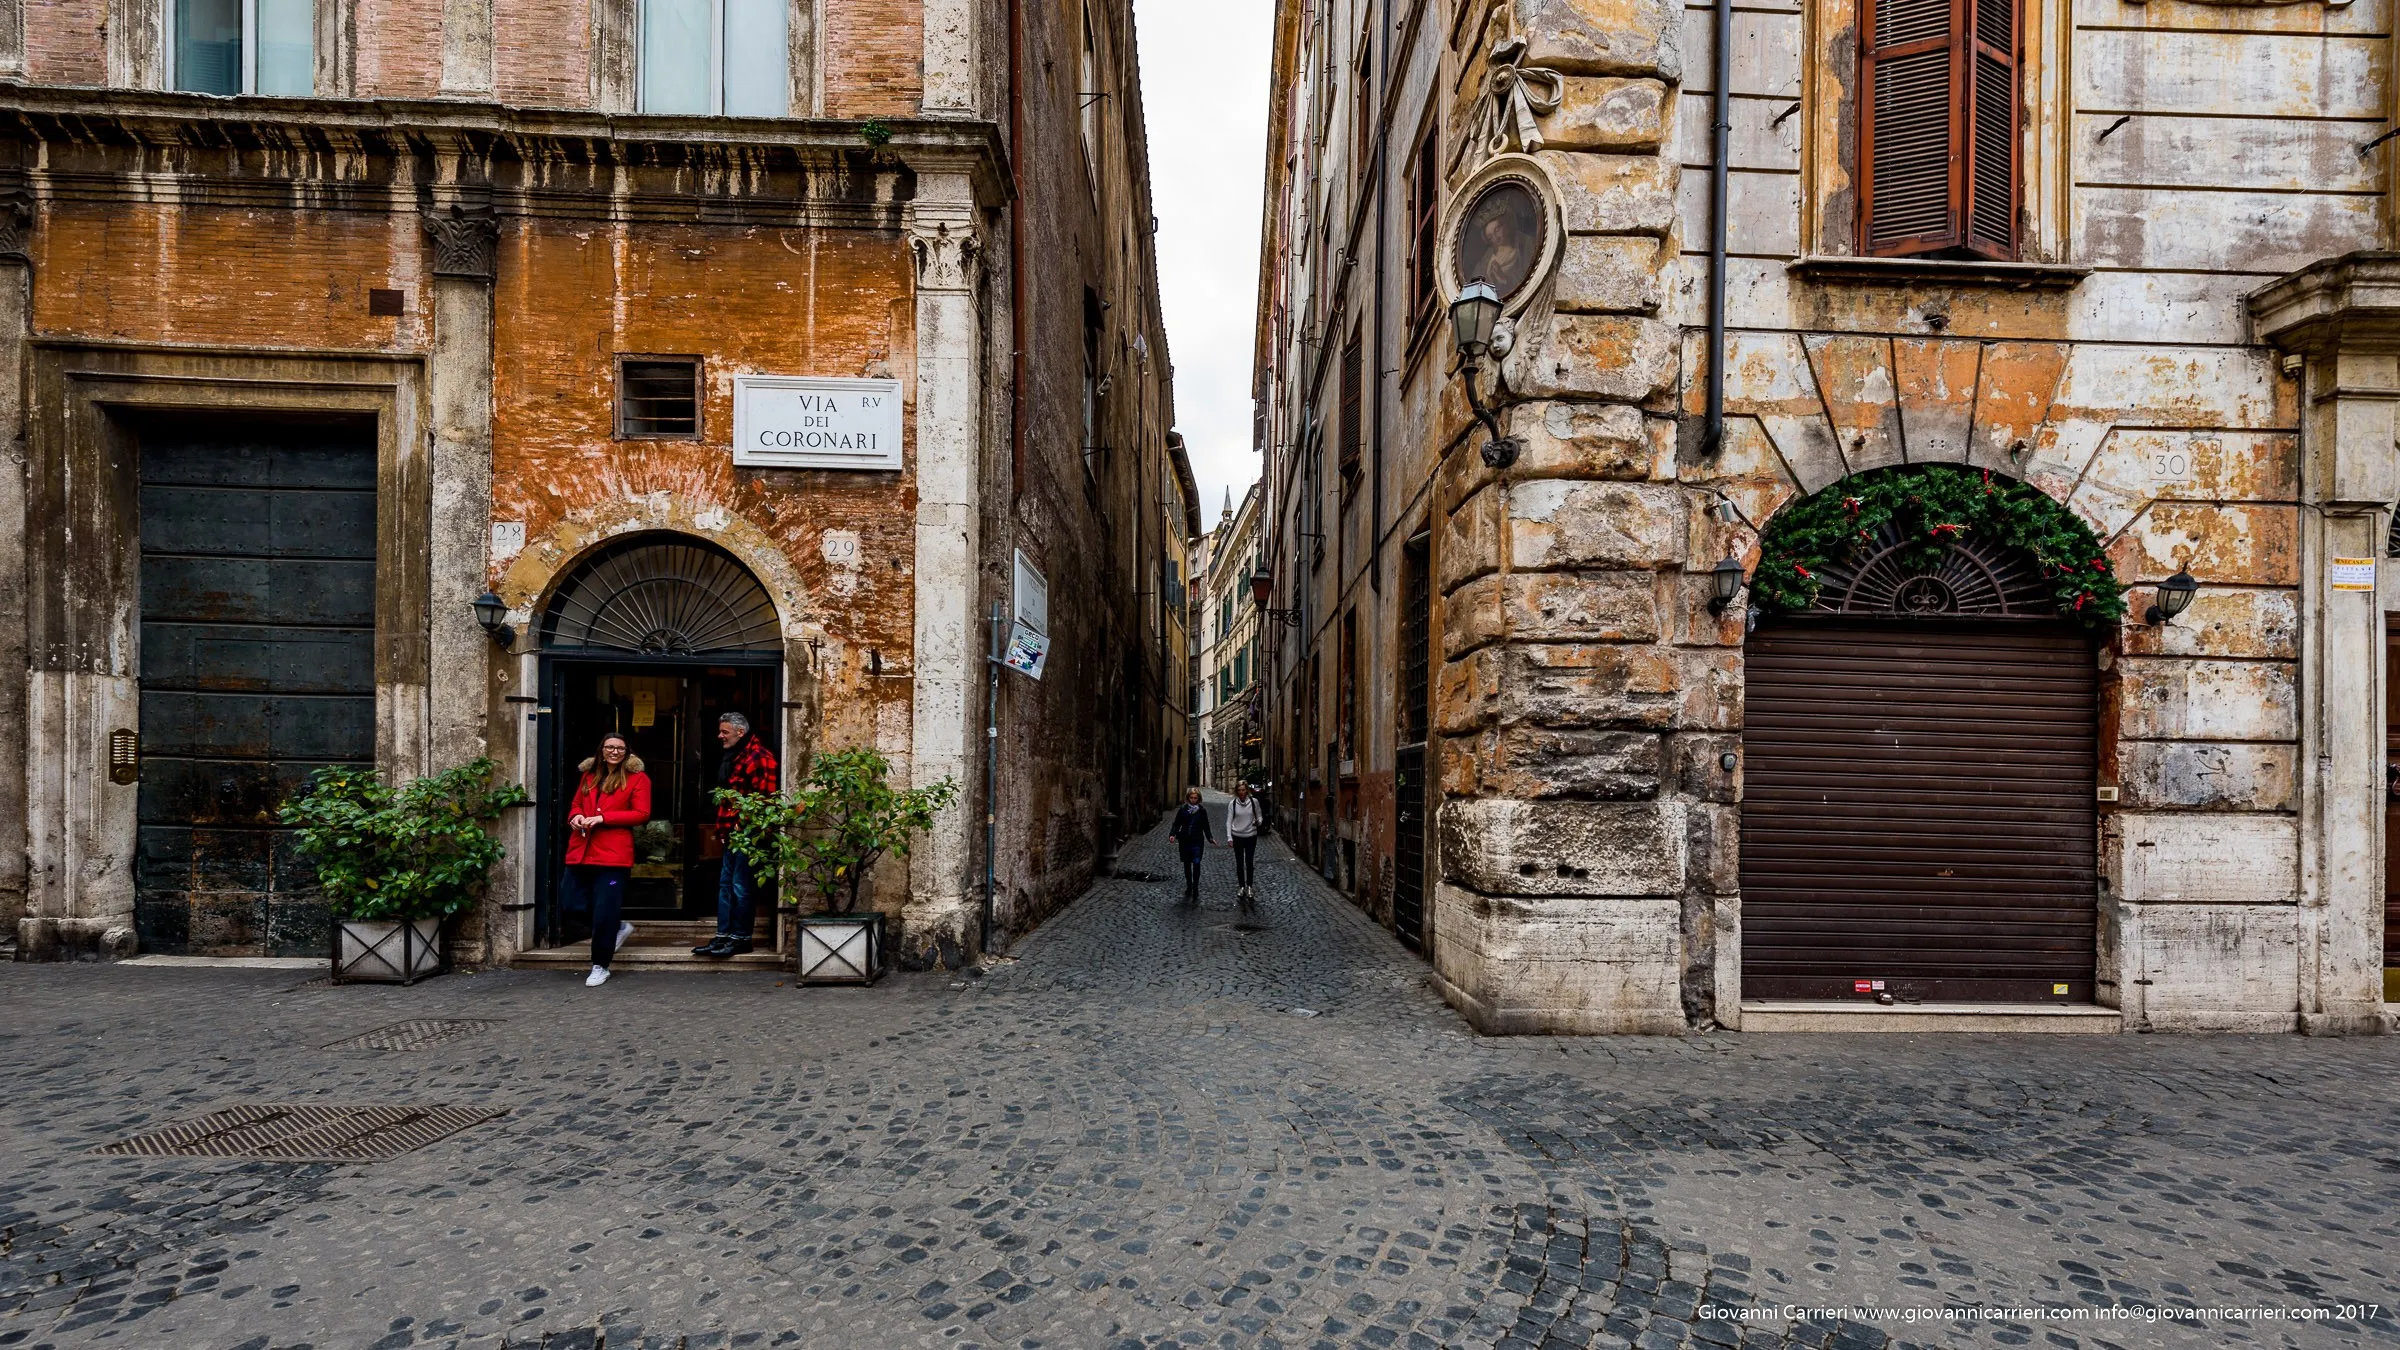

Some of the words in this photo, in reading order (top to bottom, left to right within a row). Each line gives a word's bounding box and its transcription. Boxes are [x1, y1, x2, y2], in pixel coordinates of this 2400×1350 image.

[799, 395, 837, 412] VIA
[804, 415, 829, 428] DEI
[760, 430, 876, 450] CORONARI
[2155, 454, 2186, 475] 30
[496, 524, 521, 541] 28
[828, 540, 855, 557] 29
